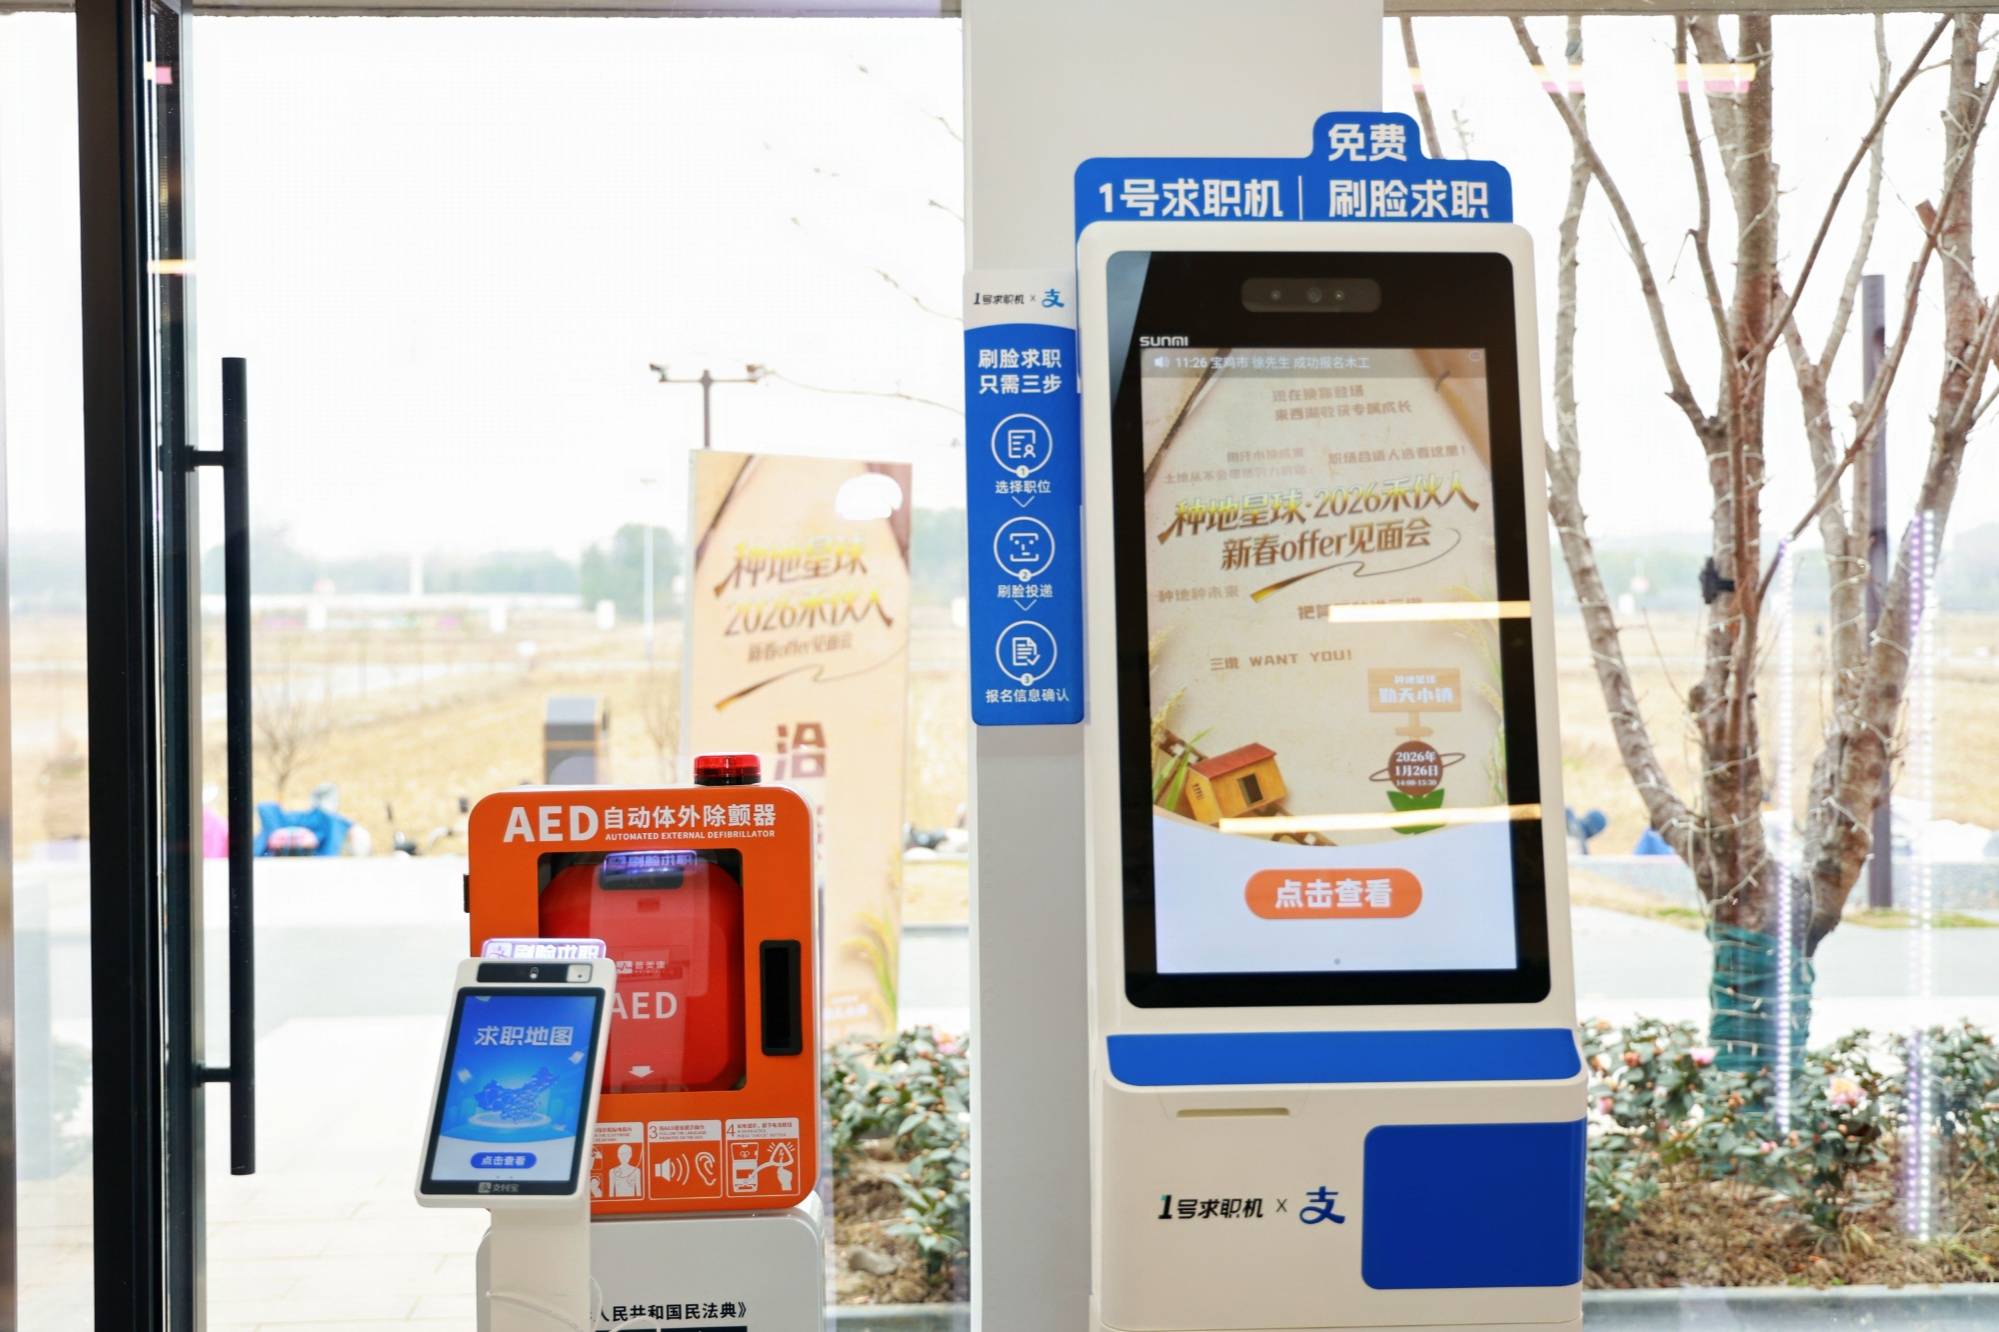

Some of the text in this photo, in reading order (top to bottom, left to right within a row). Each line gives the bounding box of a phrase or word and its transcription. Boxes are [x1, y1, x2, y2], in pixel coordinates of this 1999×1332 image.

[1328, 123, 1408, 162] 免费
[1099, 178, 1284, 218] 1号求职机
[1329, 179, 1490, 218] 刷脸求职
[973, 292, 1025, 305] 1号求职机
[978, 348, 1062, 368] 刷脸求职
[1176, 357, 1207, 368] 11:26
[979, 374, 1063, 394] 只需三步
[995, 480, 1051, 493] 选择职位
[1221, 516, 1431, 571] 新春offer见面会
[997, 584, 1053, 598] 刷脸投递
[1249, 653, 1299, 667] WANT
[1310, 649, 1352, 664] YOU!
[985, 688, 1069, 703] 报名信息确认
[1395, 751, 1436, 762] 2026年
[1395, 765, 1438, 777] 1月26日
[503, 804, 776, 842] AED 自动体外除颤器
[605, 830, 776, 841] AUTOMATED EXTERNAL DEFIBRILLATOR
[1275, 878, 1392, 908] 点击查看
[612, 991, 678, 1020] AED
[474, 1025, 574, 1046] 求职地图
[649, 1126, 657, 1138] 3
[727, 1124, 736, 1137] 4
[481, 1155, 526, 1166] 点击查看
[1158, 1194, 1264, 1219] 1号求职机
